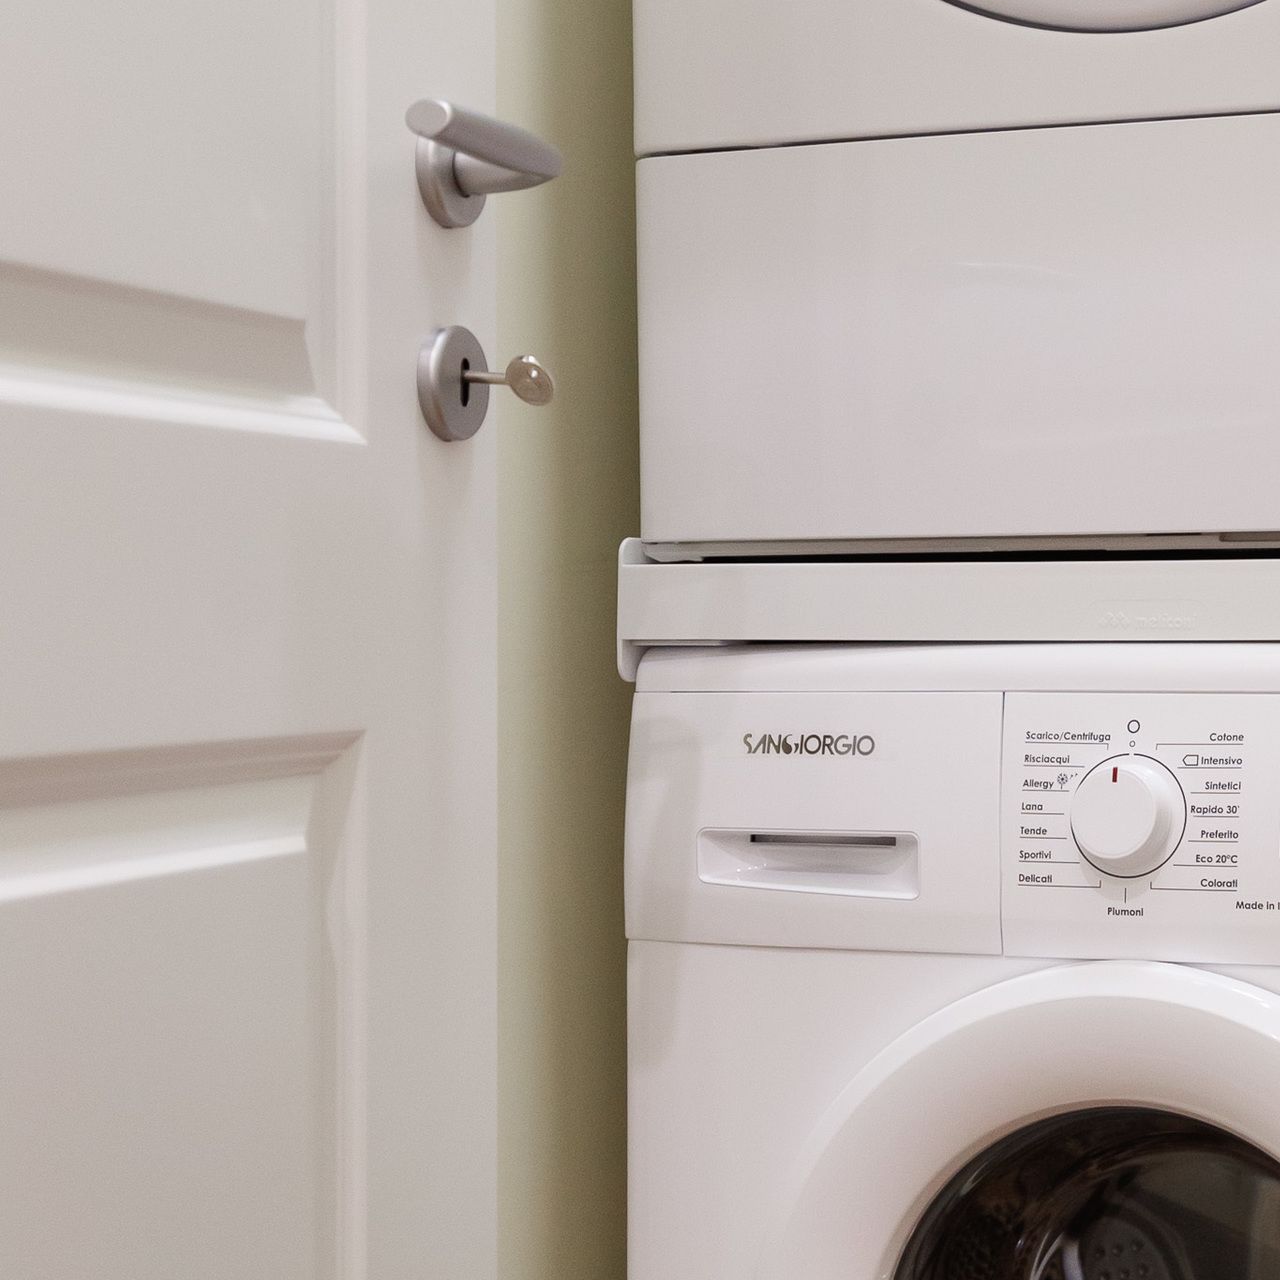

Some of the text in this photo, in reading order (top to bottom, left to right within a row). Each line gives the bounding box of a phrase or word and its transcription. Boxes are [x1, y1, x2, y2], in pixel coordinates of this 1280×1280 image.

[1025, 730, 1111, 742] Scarico/Centrifuga
[1209, 732, 1245, 742] Cotone
[1024, 754, 1070, 765] Risciacqui
[1201, 756, 1243, 765] Intensivo
[1022, 779, 1054, 790] Allergy
[1205, 781, 1242, 791] Sintetici
[1021, 802, 1043, 812] Lana
[1190, 805, 1224, 816] Rapido
[1020, 826, 1048, 836] Tende
[1200, 830, 1239, 839] Preferito
[1019, 850, 1052, 861] Sportivi
[1195, 854, 1238, 864] Eco 20°C
[1018, 874, 1052, 883] Delicati
[1200, 878, 1238, 888] Colorati
[1235, 901, 1264, 910] Made
[1266, 901, 1275, 911] in
[1107, 907, 1144, 917] Piumoni
